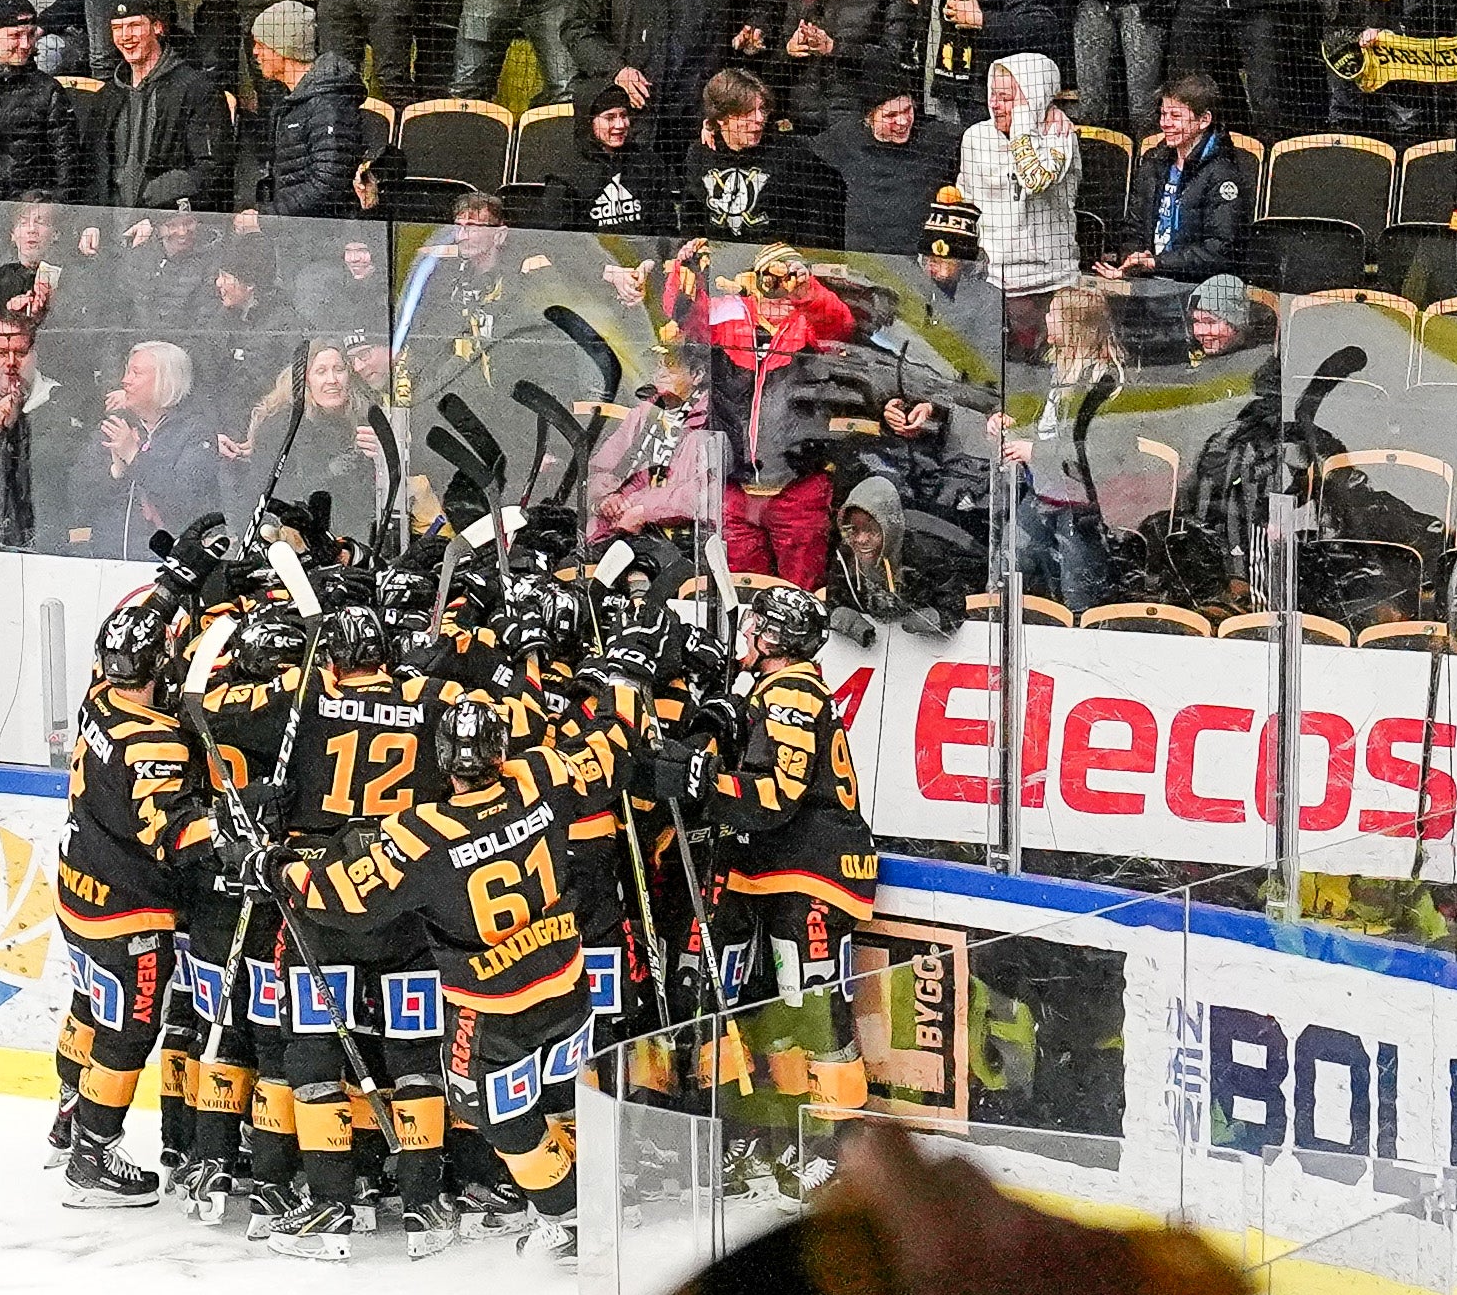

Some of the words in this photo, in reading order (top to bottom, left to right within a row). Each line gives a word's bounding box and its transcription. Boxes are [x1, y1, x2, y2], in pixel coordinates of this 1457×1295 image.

[590, 197, 643, 222] adidas
[322, 697, 425, 728] BOLIDEN
[321, 729, 418, 817] 12
[453, 801, 555, 869] BOLIDEN
[60, 861, 112, 908] WAY
[467, 835, 561, 947] 61
[132, 951, 158, 1024] REPAY
[913, 953, 946, 1049] BYGG
